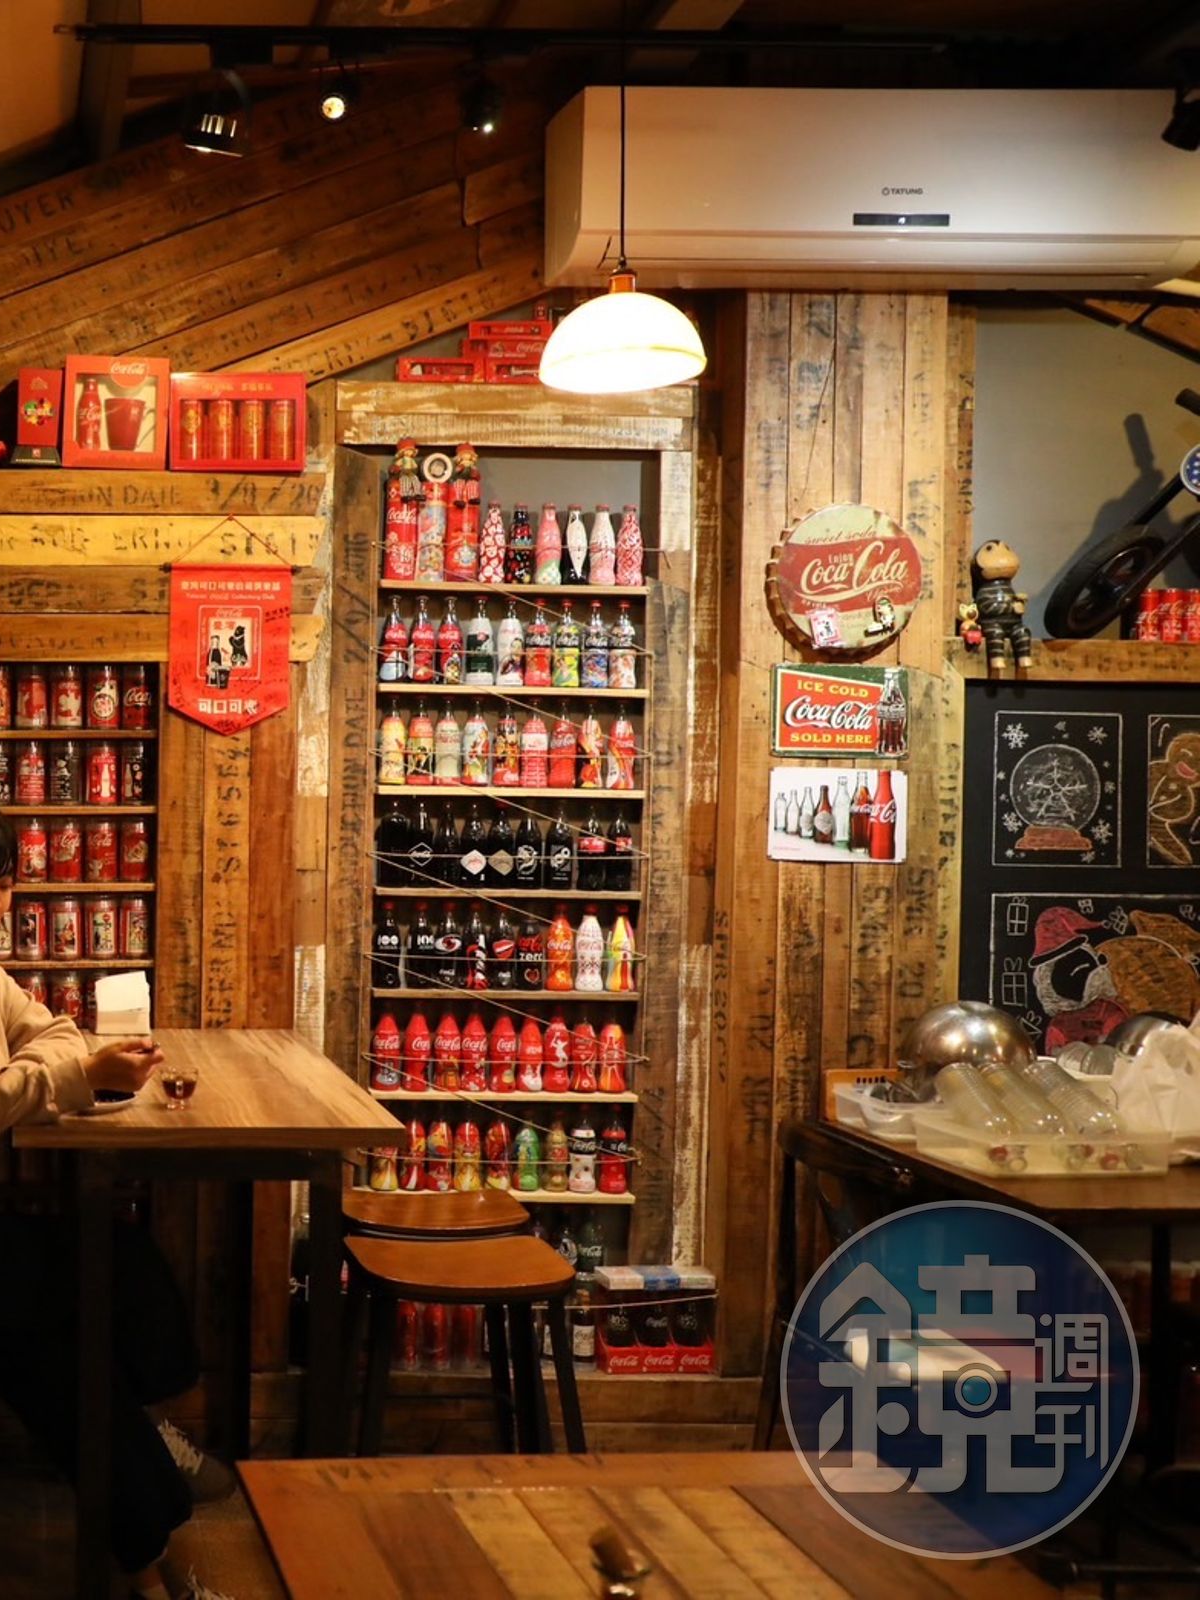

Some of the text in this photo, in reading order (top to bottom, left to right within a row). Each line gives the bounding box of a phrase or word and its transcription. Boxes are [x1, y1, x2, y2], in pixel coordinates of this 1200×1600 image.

[890, 187, 924, 196] TATUNG
[797, 680, 869, 698] ICE COLD
[790, 732, 873, 744] SOLD HERE
[377, 934, 399, 946] 100
